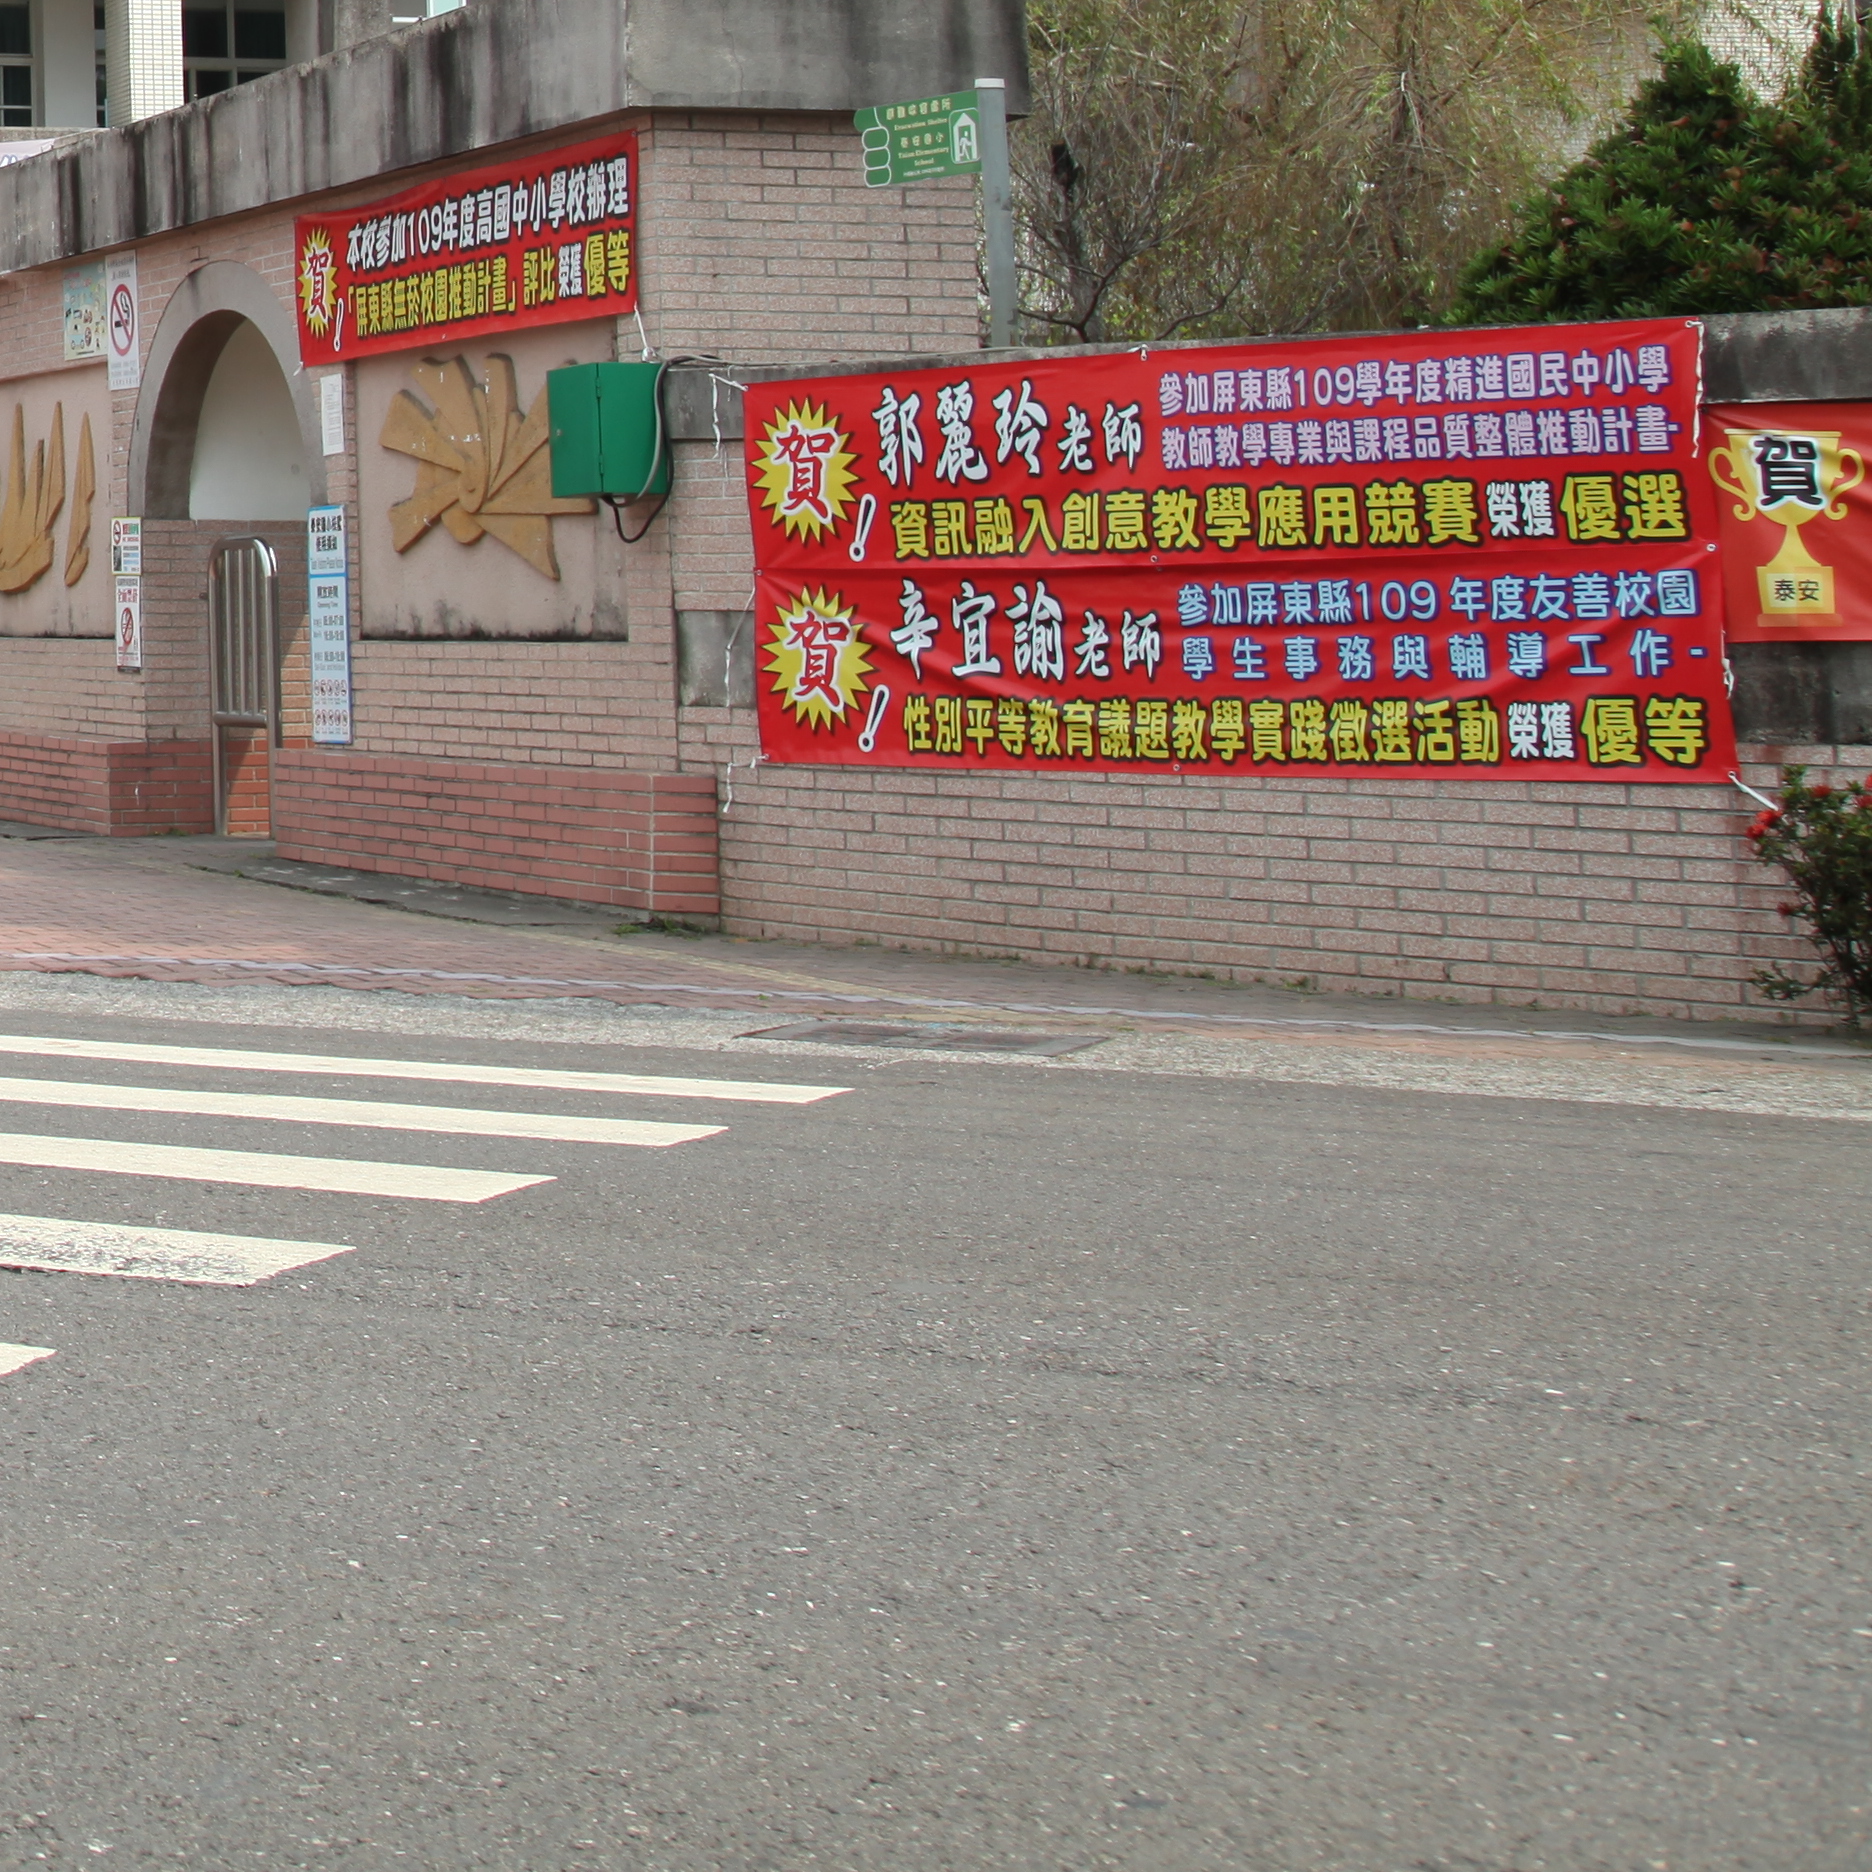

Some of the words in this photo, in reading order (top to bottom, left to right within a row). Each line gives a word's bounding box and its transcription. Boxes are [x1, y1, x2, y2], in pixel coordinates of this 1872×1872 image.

[347, 157, 628, 271] 本校參加109年度高國中小學校辦理
[1158, 345, 1669, 416] 參加屏東縣109學年度精進國民中小學
[1754, 435, 1824, 507] 賀
[1774, 578, 1820, 602] 泰安
